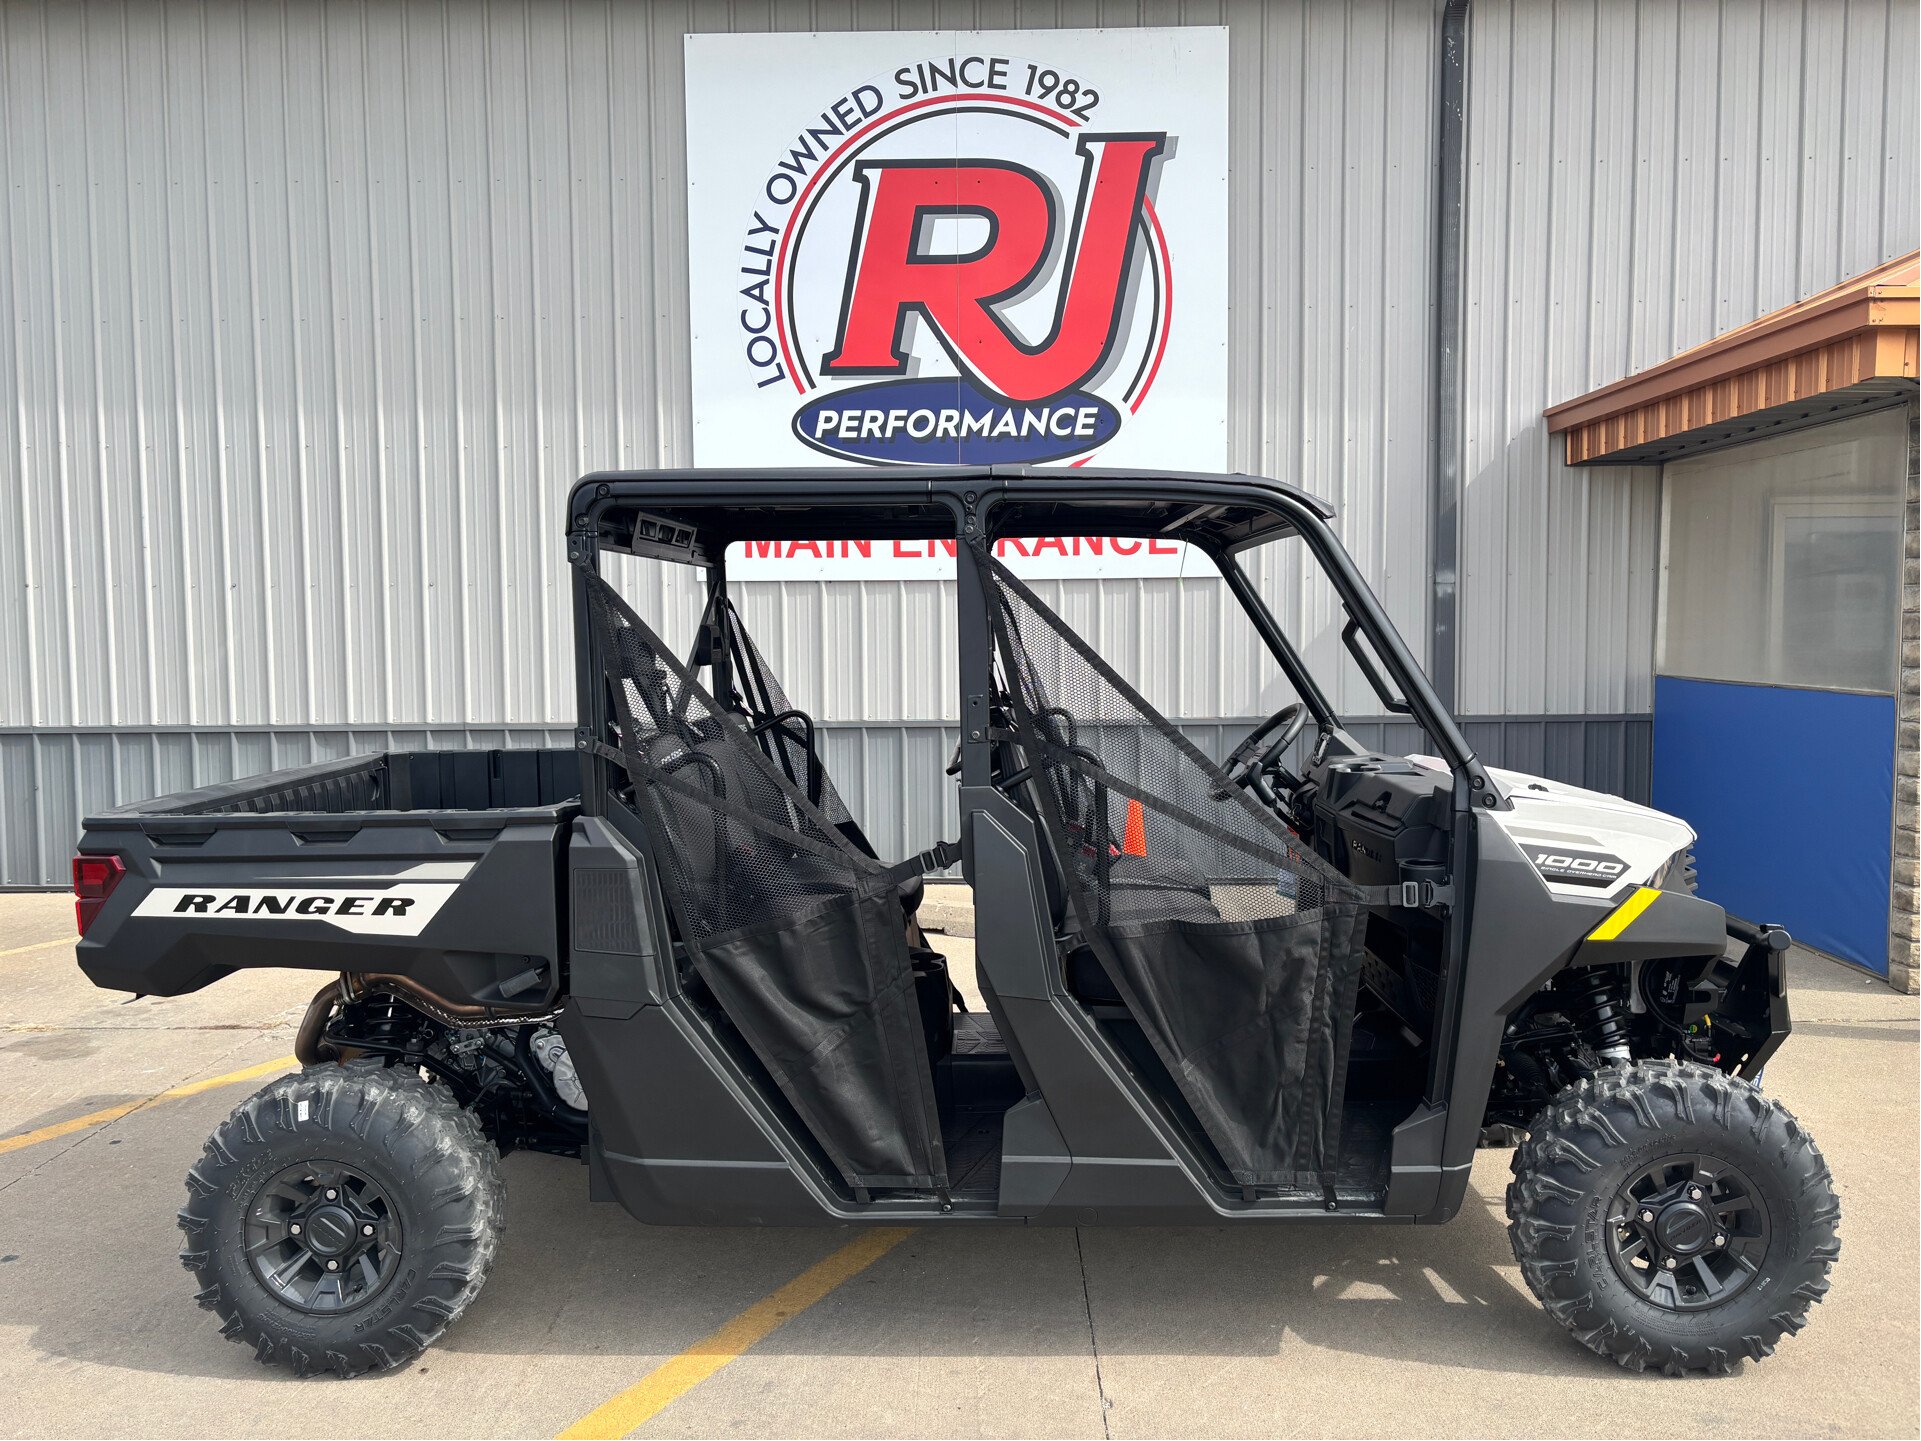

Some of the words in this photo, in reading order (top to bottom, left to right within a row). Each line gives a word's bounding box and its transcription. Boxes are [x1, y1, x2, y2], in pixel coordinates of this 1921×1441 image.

[739, 210, 786, 389] LOCALLY
[766, 84, 884, 205] OWNED
[894, 56, 1010, 100] SINCE
[1024, 63, 1100, 123] 1982
[819, 131, 1168, 407] RJ
[814, 406, 1099, 439] PERFORMANCE
[1534, 853, 1624, 874] 1000
[172, 894, 416, 917] RANGER
